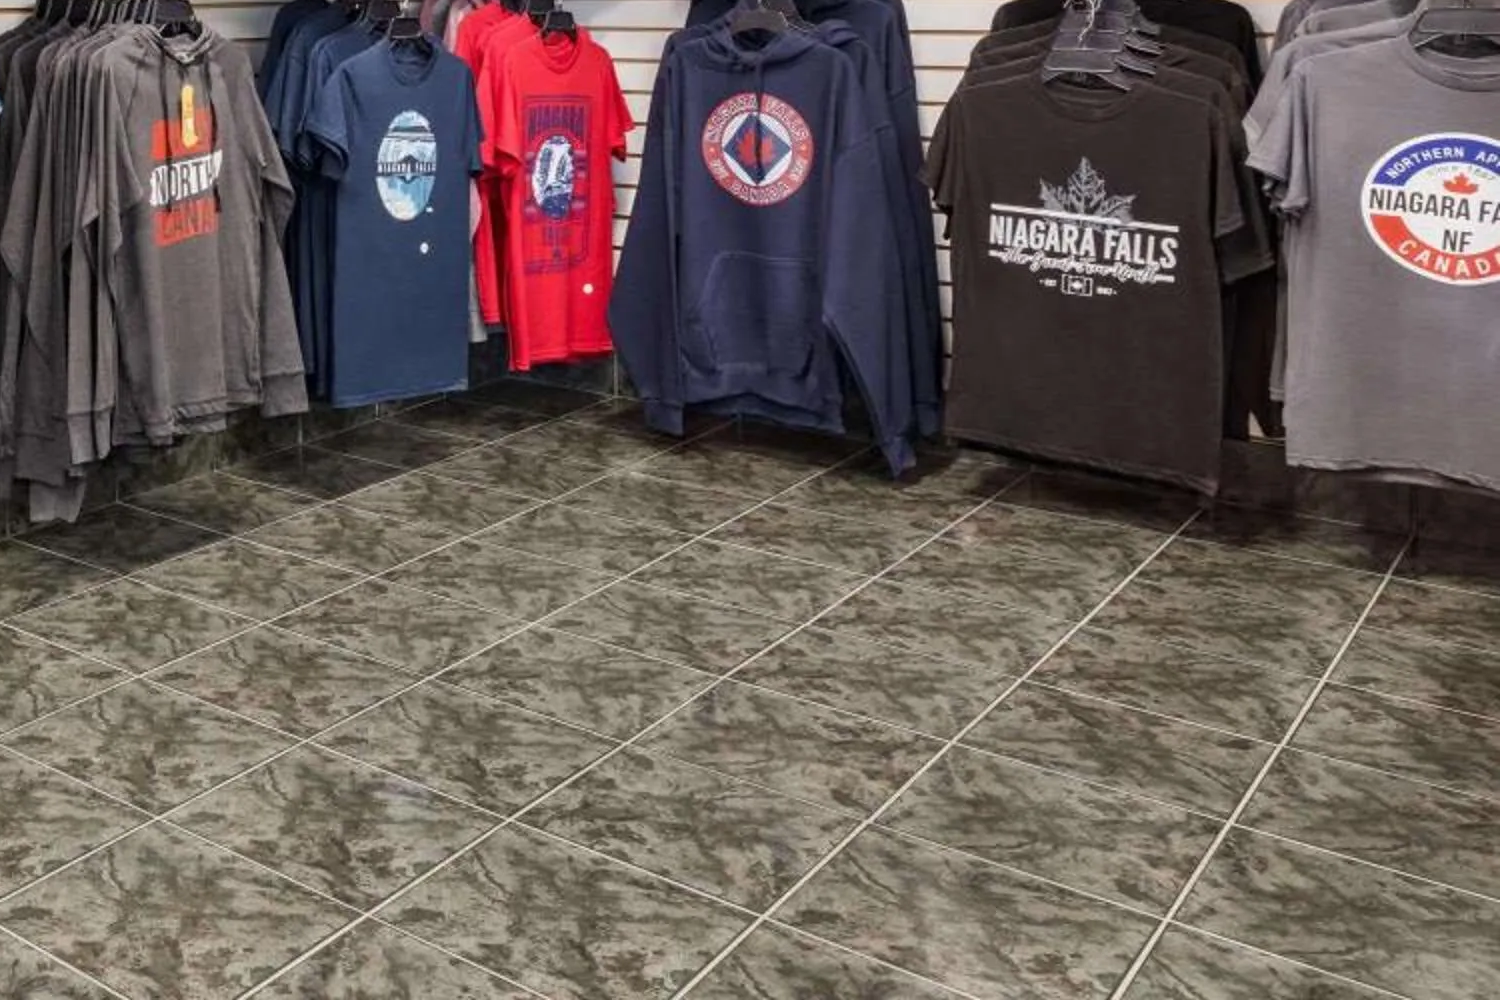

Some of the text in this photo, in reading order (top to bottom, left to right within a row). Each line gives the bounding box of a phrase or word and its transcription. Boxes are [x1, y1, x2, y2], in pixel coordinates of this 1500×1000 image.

[1386, 146, 1466, 180] NORTHERN
[1368, 187, 1471, 222] NIAGARA
[989, 214, 1097, 258] NIAGARA
[1103, 228, 1180, 270] FALLS
[1442, 229, 1475, 253] NF
